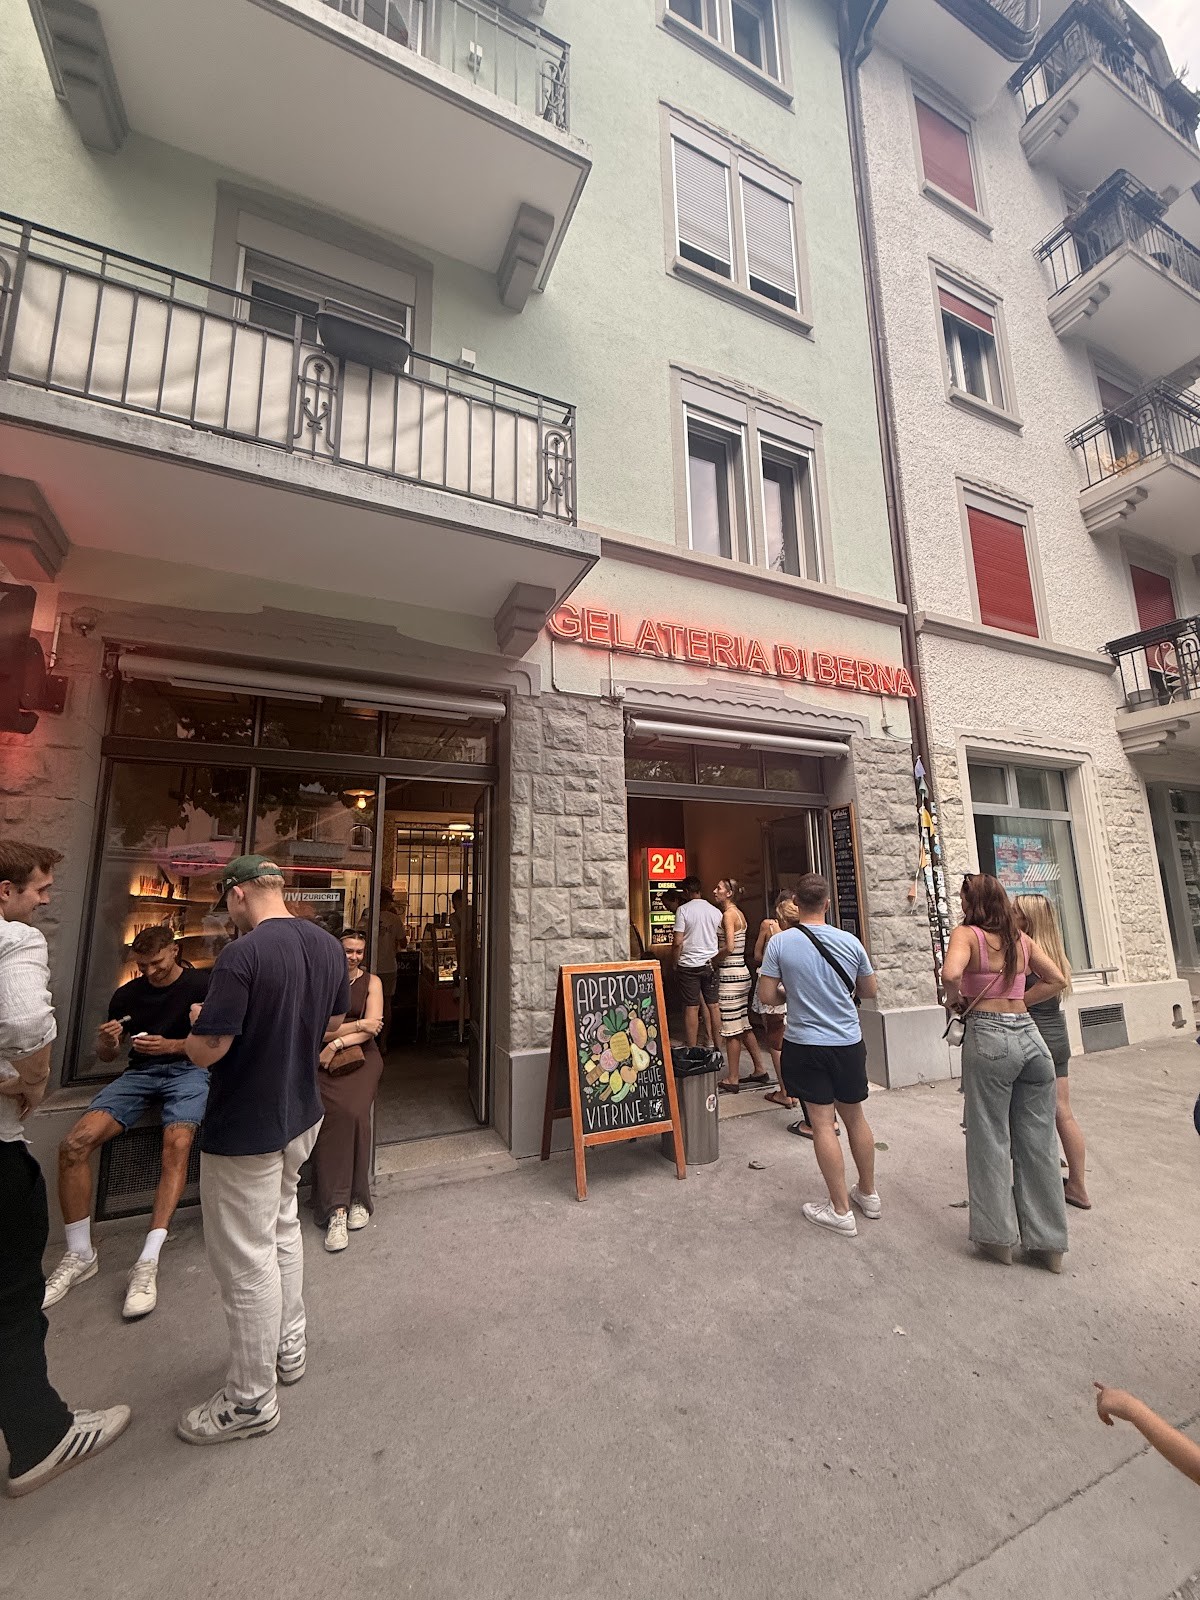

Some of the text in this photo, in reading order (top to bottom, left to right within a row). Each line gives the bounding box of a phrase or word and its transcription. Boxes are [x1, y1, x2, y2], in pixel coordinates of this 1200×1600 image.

[546, 603, 916, 697] GELATERIA DI BERNA
[652, 852, 683, 874] 24h
[637, 973, 654, 983] MO-SO
[577, 975, 638, 1014] APERTO
[638, 1065, 662, 1084] HEUTE
[639, 1082, 666, 1098] IN DER
